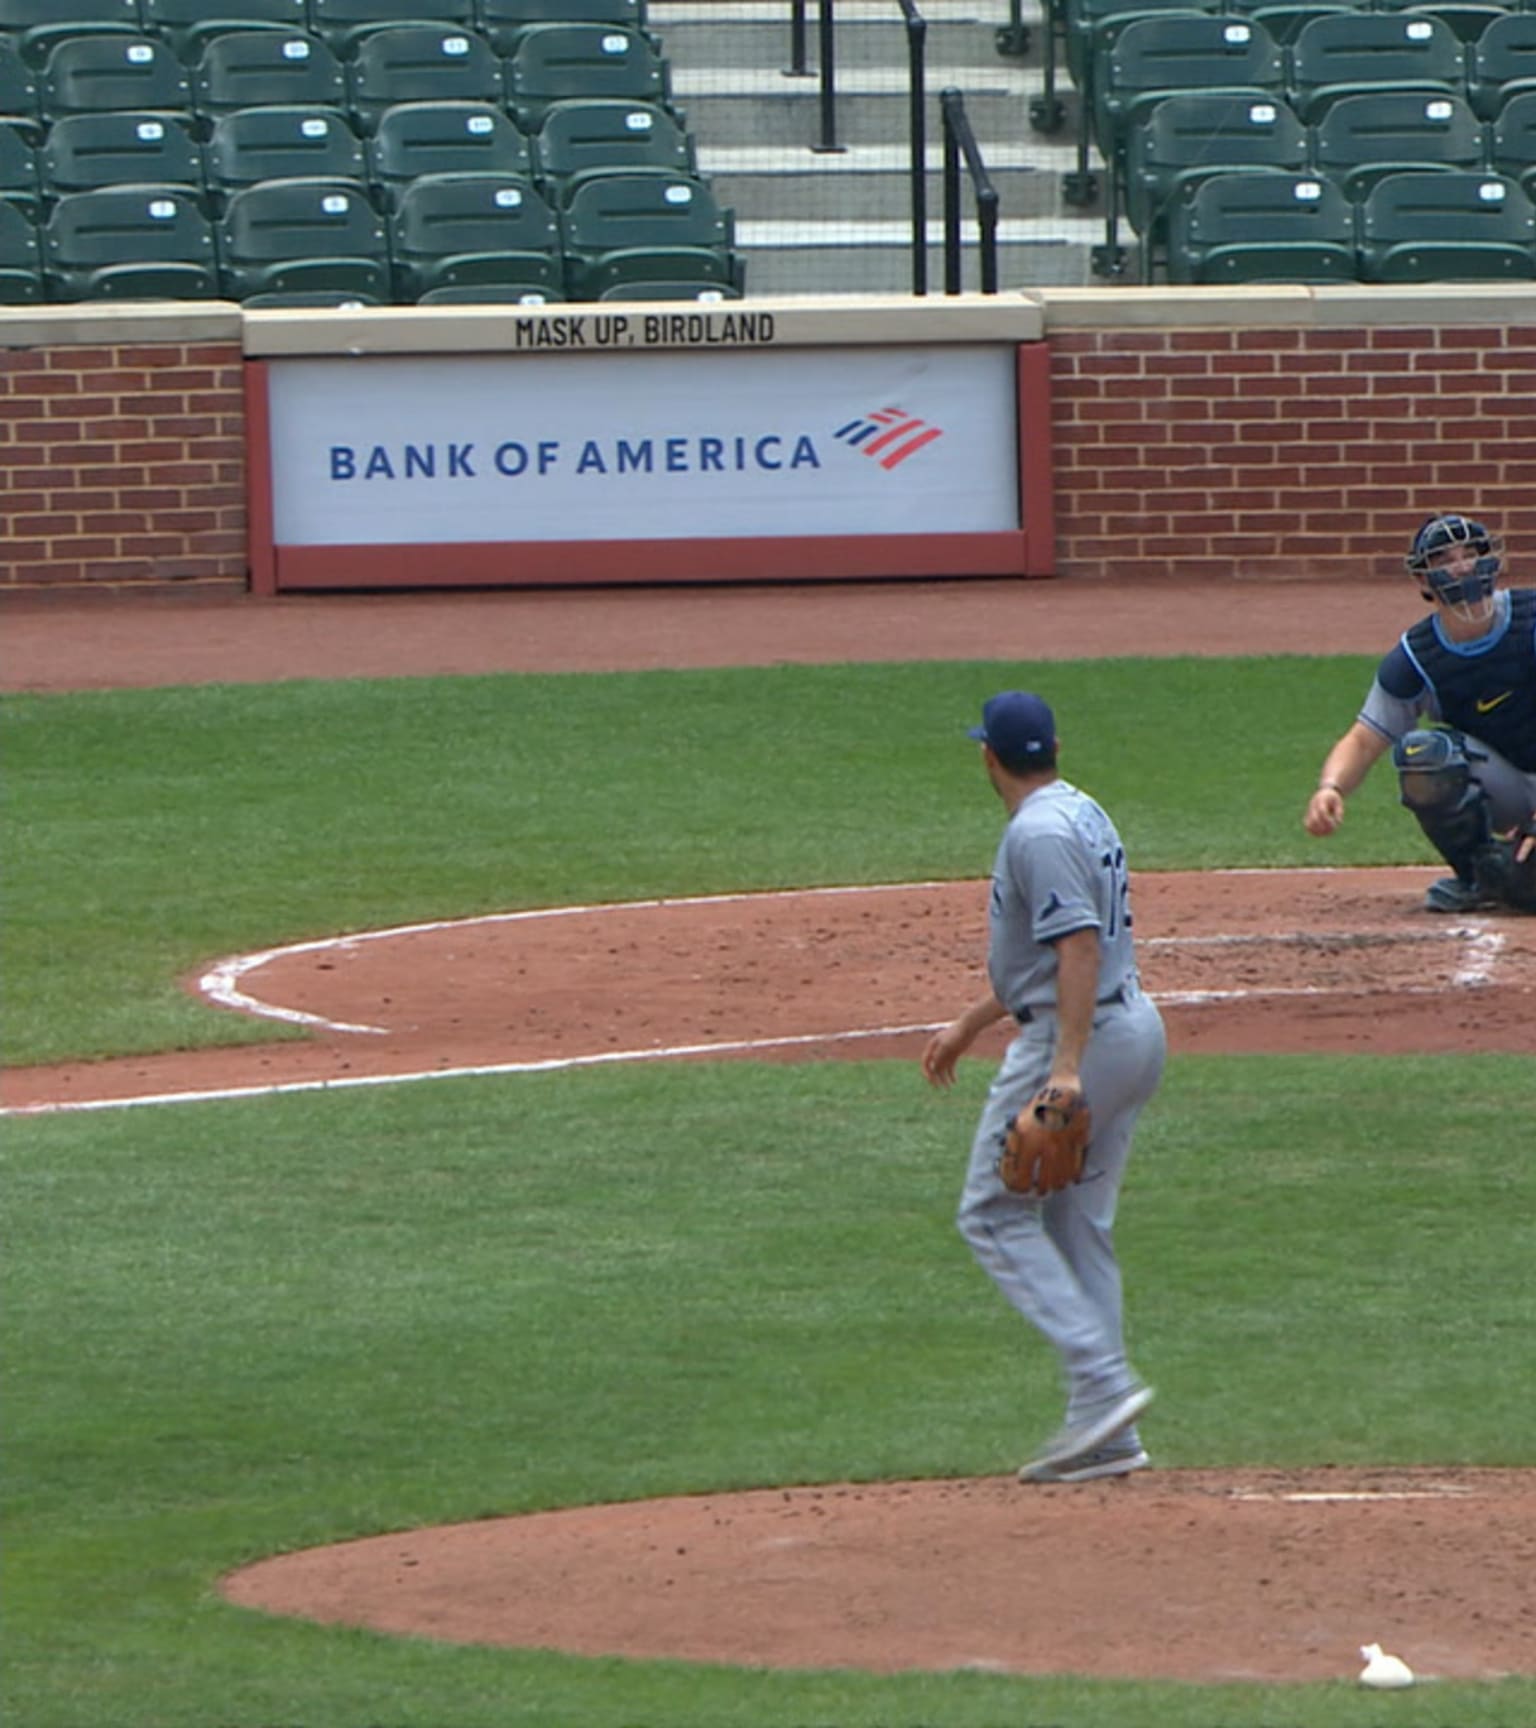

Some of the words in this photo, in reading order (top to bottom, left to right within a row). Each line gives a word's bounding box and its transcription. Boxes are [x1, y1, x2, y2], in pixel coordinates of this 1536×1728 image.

[515, 317, 586, 347] MASK
[594, 315, 636, 345] UP,
[644, 312, 775, 344] BIRDLAND
[329, 442, 477, 481] BANK
[493, 440, 561, 477] OF
[575, 435, 822, 475] AMERICA
